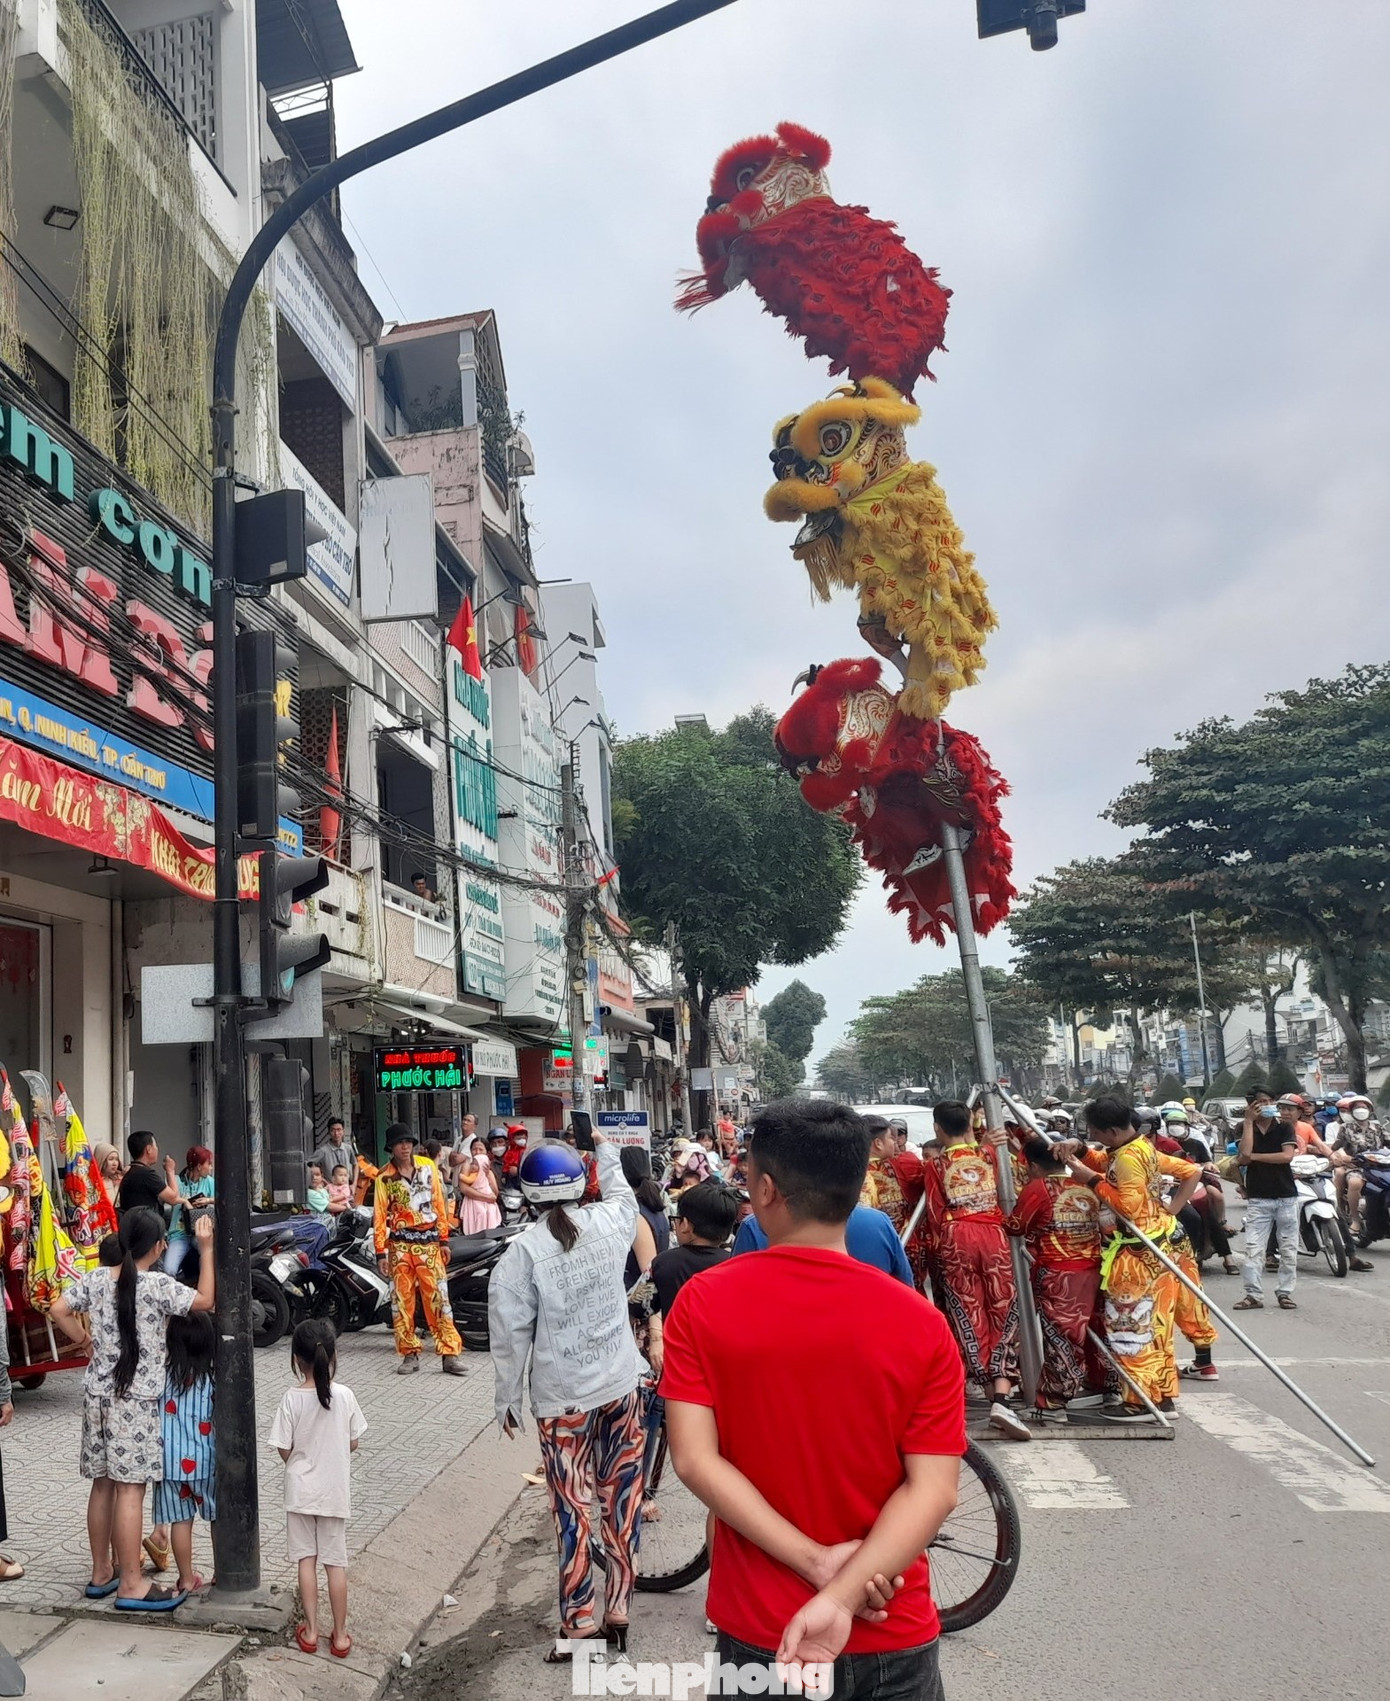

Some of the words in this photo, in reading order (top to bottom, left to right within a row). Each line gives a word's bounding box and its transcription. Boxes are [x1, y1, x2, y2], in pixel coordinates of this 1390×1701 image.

[34, 714, 67, 745] NINH
[102, 745, 120, 770] TP.
[0, 758, 42, 812] ăm
[46, 776, 94, 832] Mới
[151, 828, 182, 882] KHAI
[385, 1051, 410, 1064] NHÀ
[414, 1049, 456, 1063] THUỐC
[381, 1065, 432, 1089] PHƯỚC
[435, 1063, 461, 1088] HẢI
[604, 1113, 640, 1122] microlife
[565, 1296, 595, 1316] LOVE
[557, 1315, 585, 1330] WILL
[576, 1349, 601, 1369] YOU
